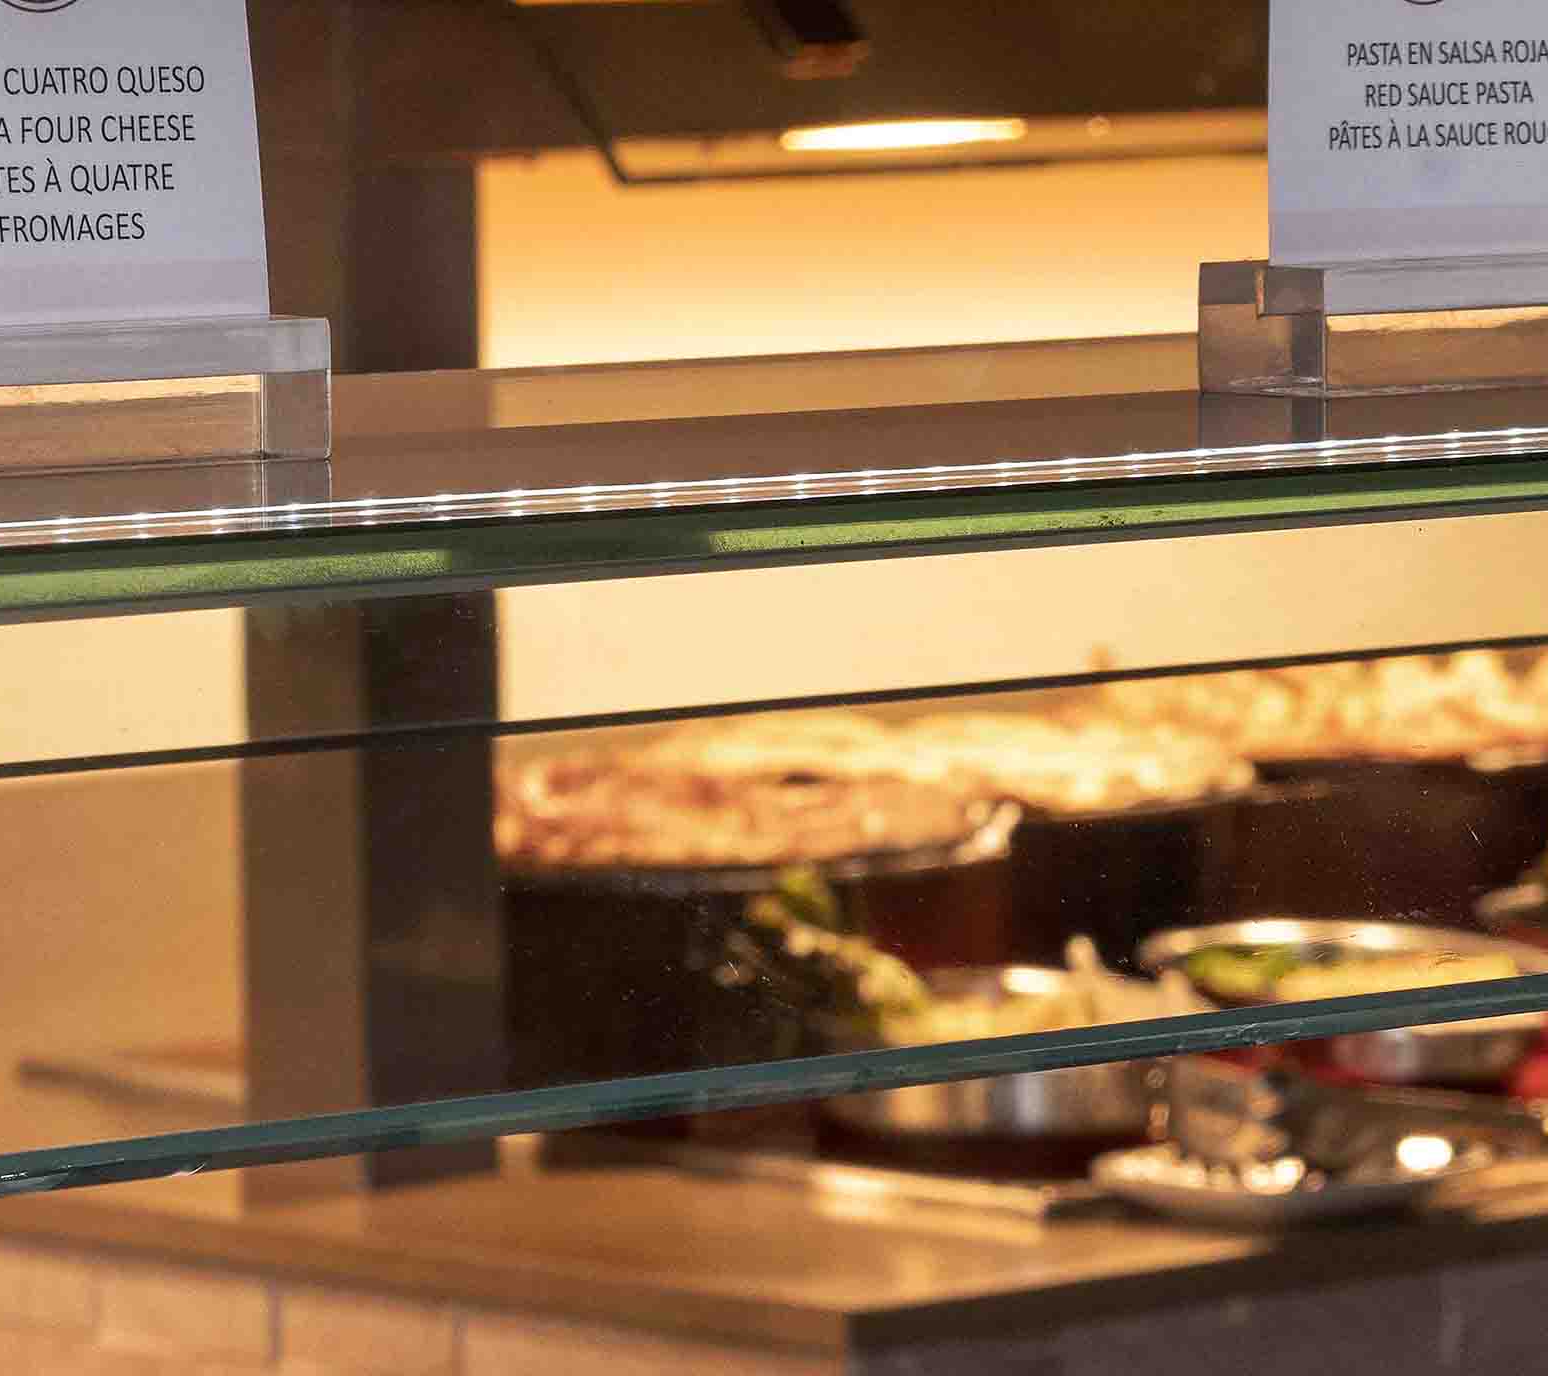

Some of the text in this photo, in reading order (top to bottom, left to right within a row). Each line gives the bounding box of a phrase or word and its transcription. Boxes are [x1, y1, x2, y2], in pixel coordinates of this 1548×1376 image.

[1347, 41, 1403, 67] PASTA
[1407, 40, 1433, 66] EN
[1437, 38, 1498, 65] SALSA
[3, 65, 109, 96] CUATRO
[116, 64, 205, 97] QUESO
[1364, 79, 1535, 109] RED SAUCE PASTA
[20, 114, 93, 145] FOUR
[100, 113, 197, 143] CHEESE
[1328, 118, 1383, 151] PÂTES
[1387, 117, 1402, 150] À
[1406, 123, 1432, 148] LA
[1435, 121, 1499, 148] SAUCE
[43, 157, 63, 193] À
[70, 162, 175, 196] QUATRE
